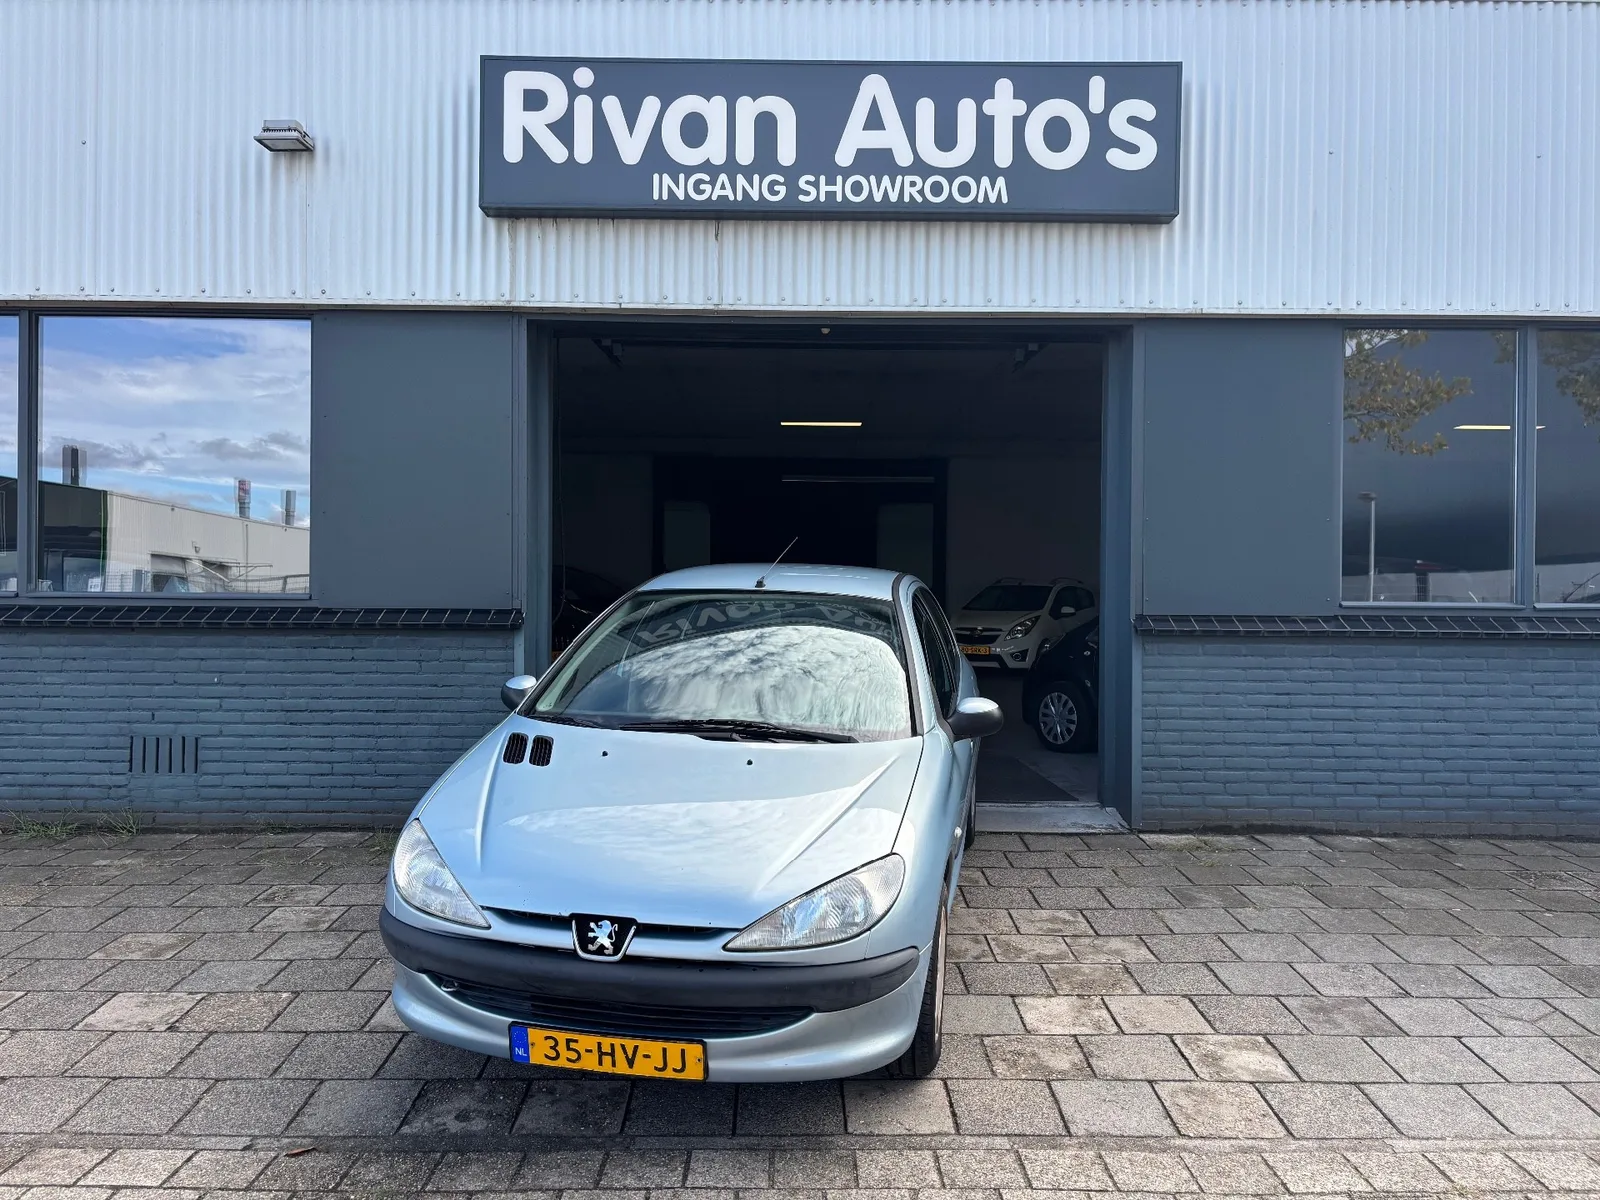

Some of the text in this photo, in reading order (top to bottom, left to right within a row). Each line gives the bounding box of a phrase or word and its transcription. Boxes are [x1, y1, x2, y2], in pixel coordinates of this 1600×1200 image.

[503, 67, 1158, 171] Rivan Auto's
[652, 172, 1009, 205] INGANG SHOWROOM
[514, 1047, 528, 1057] NL
[544, 1036, 686, 1073] 35-HV-JJ
